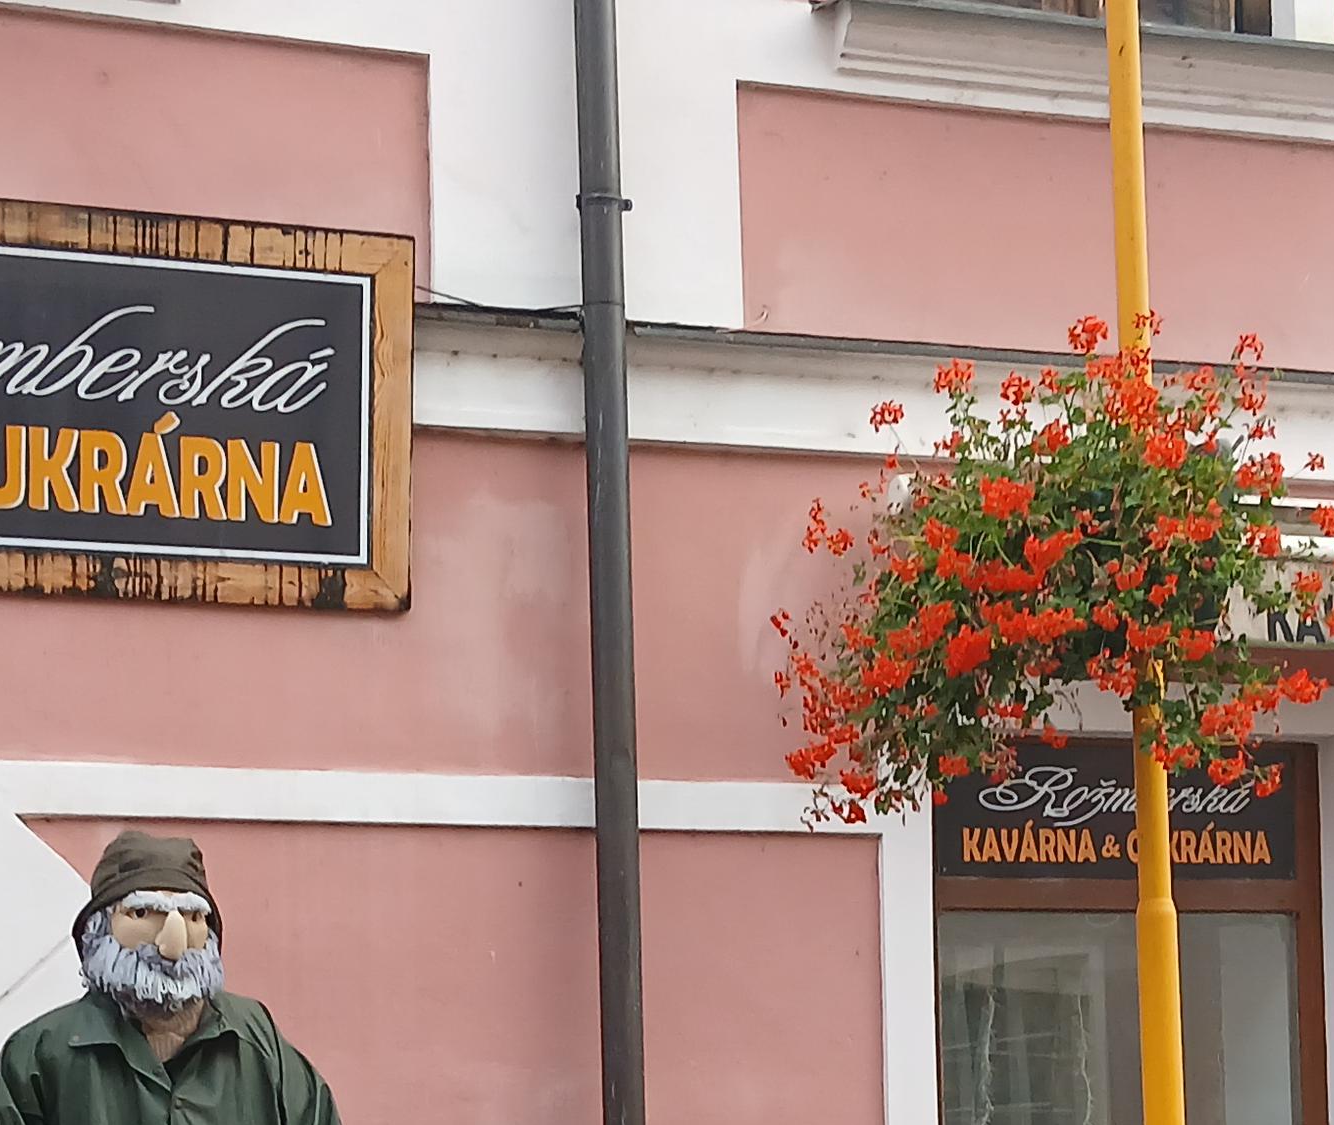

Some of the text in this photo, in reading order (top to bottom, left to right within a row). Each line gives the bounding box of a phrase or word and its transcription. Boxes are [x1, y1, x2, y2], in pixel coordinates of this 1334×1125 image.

[962, 819, 1272, 865] KAVÁRNA & CKRÁRNA
